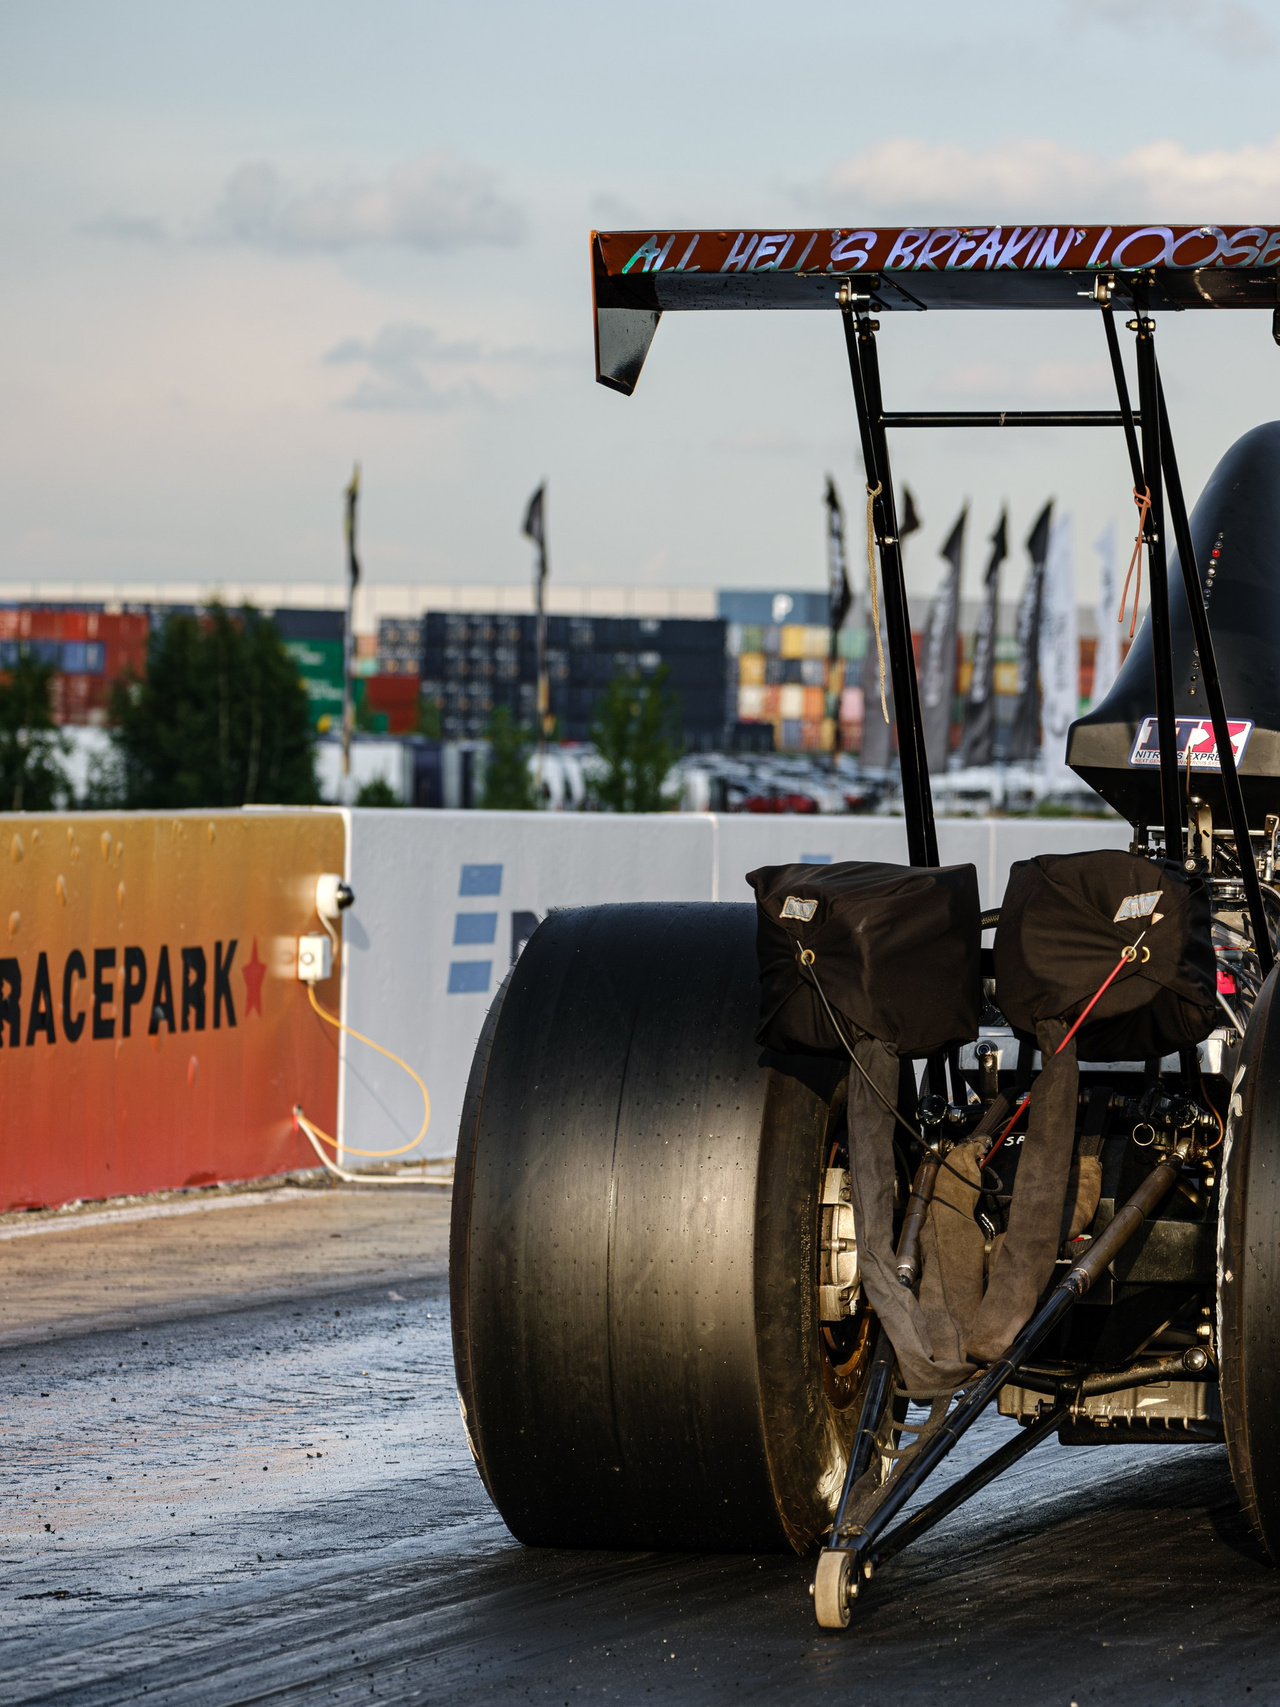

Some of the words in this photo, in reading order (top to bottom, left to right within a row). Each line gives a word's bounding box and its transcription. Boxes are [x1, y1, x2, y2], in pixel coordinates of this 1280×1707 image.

[621, 234, 701, 274] ALL
[720, 230, 878, 273] HELL'S
[1135, 750, 1184, 760] NITRS
[1186, 752, 1237, 762] EXPRE
[0, 939, 238, 1048] RACEPARK
